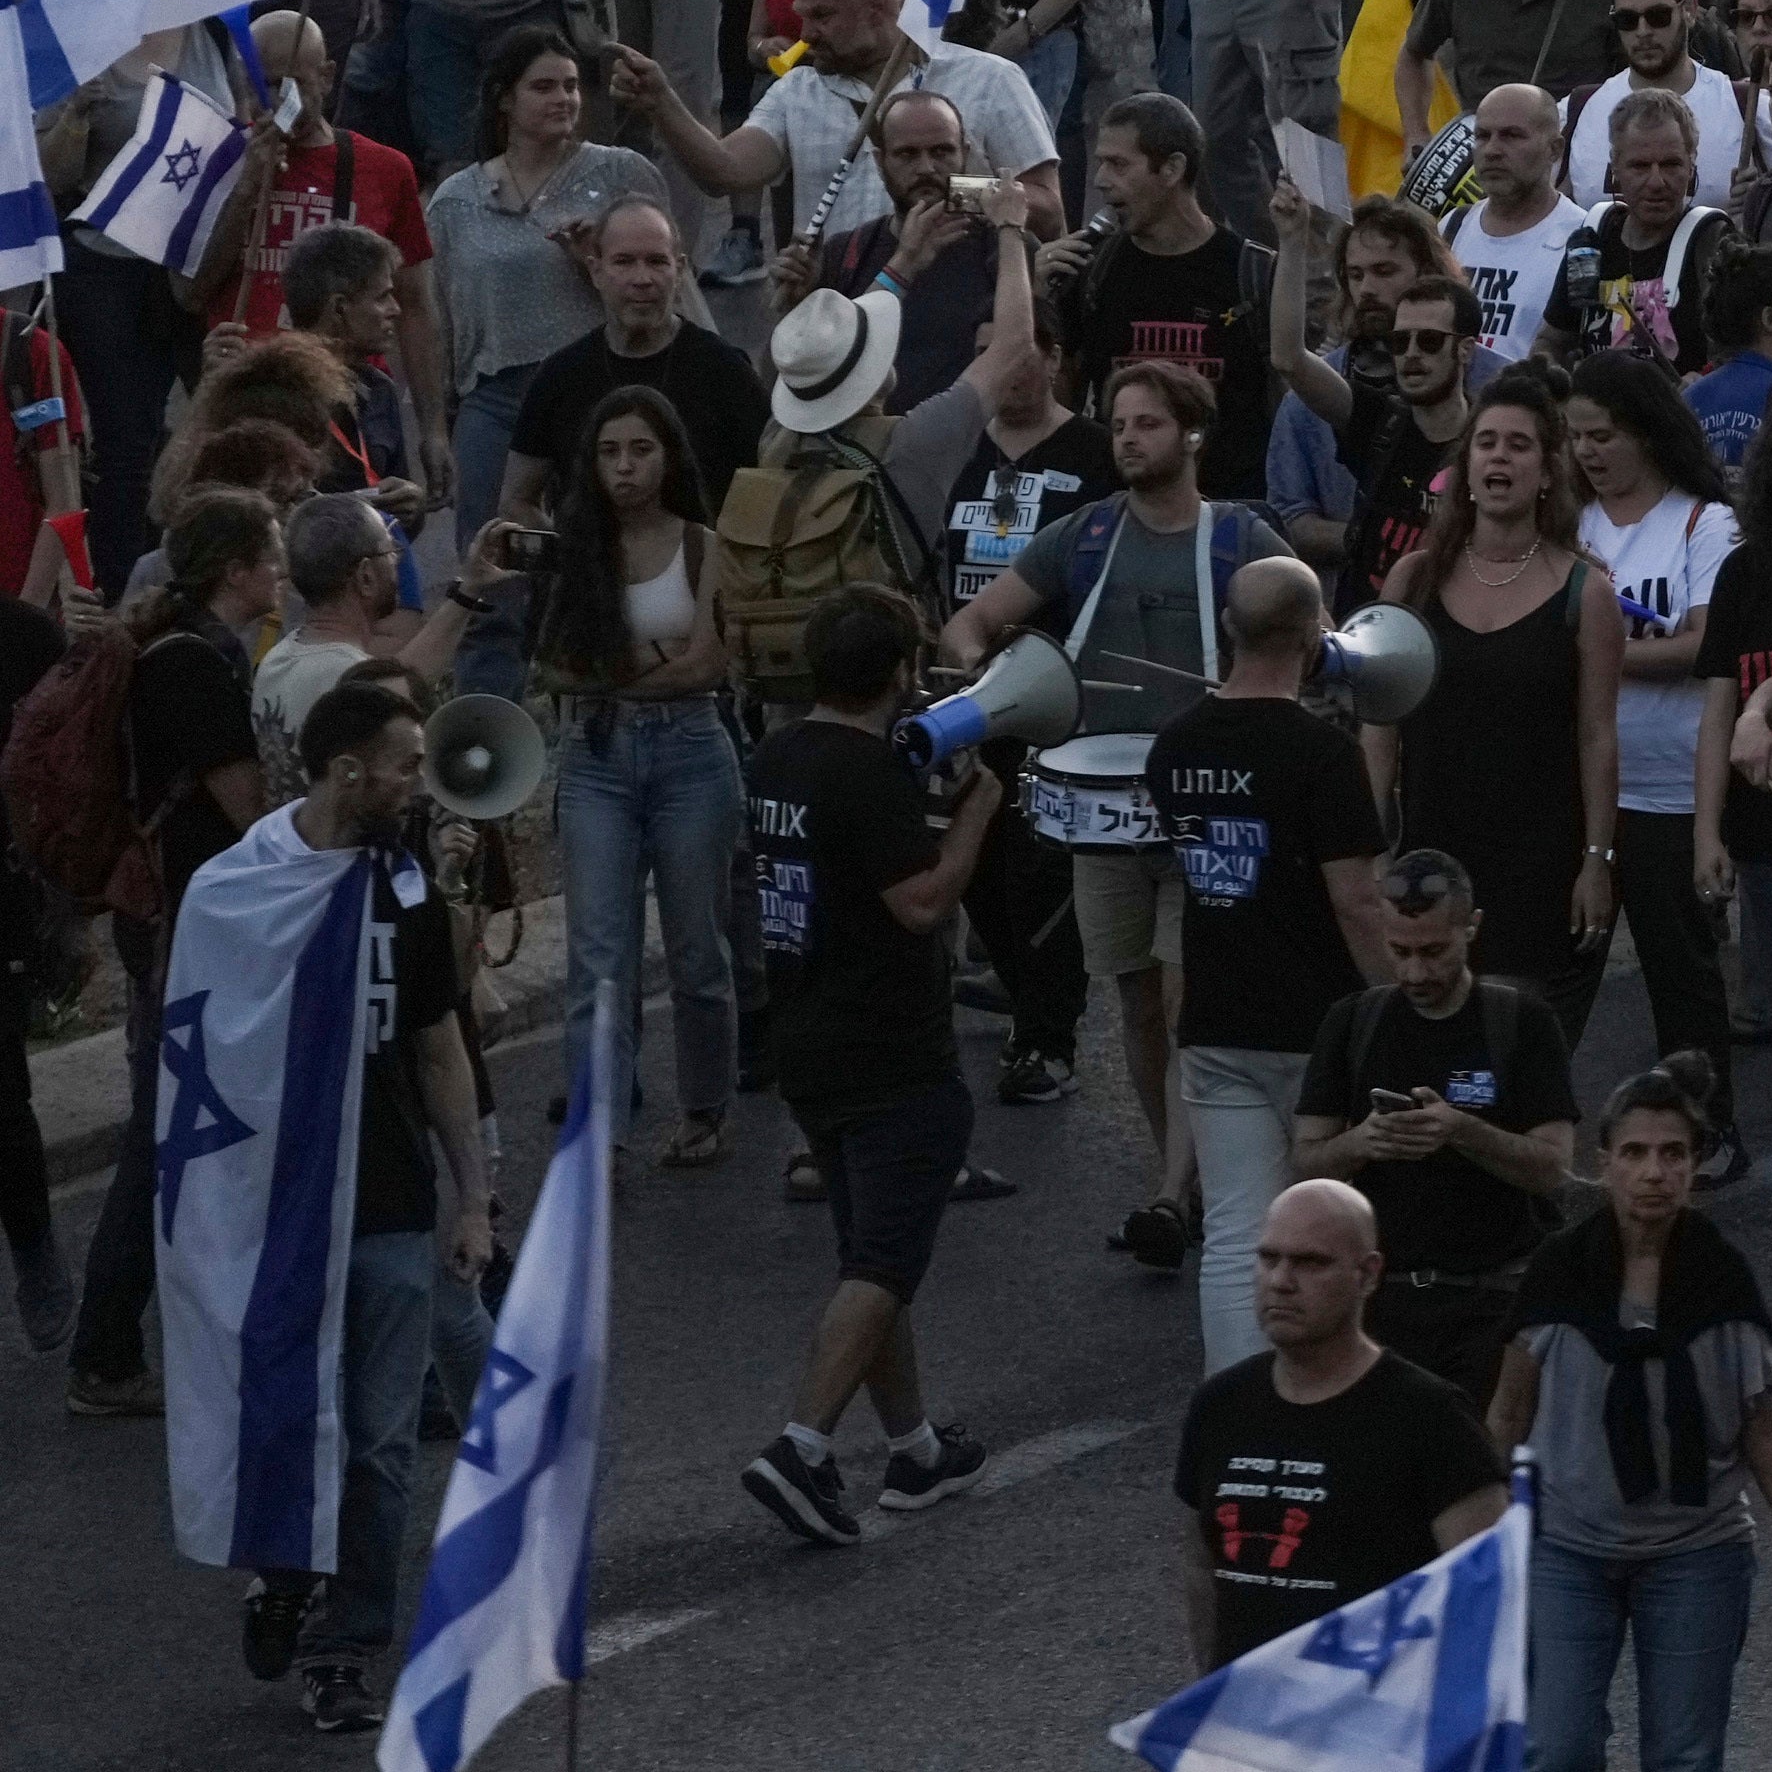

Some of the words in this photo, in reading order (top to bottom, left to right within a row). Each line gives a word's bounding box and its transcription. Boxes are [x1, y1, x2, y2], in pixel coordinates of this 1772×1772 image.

[1171, 768, 1252, 796] אנחנו
[1210, 820, 1263, 848] היום
[1175, 847, 1257, 882] שאחר
